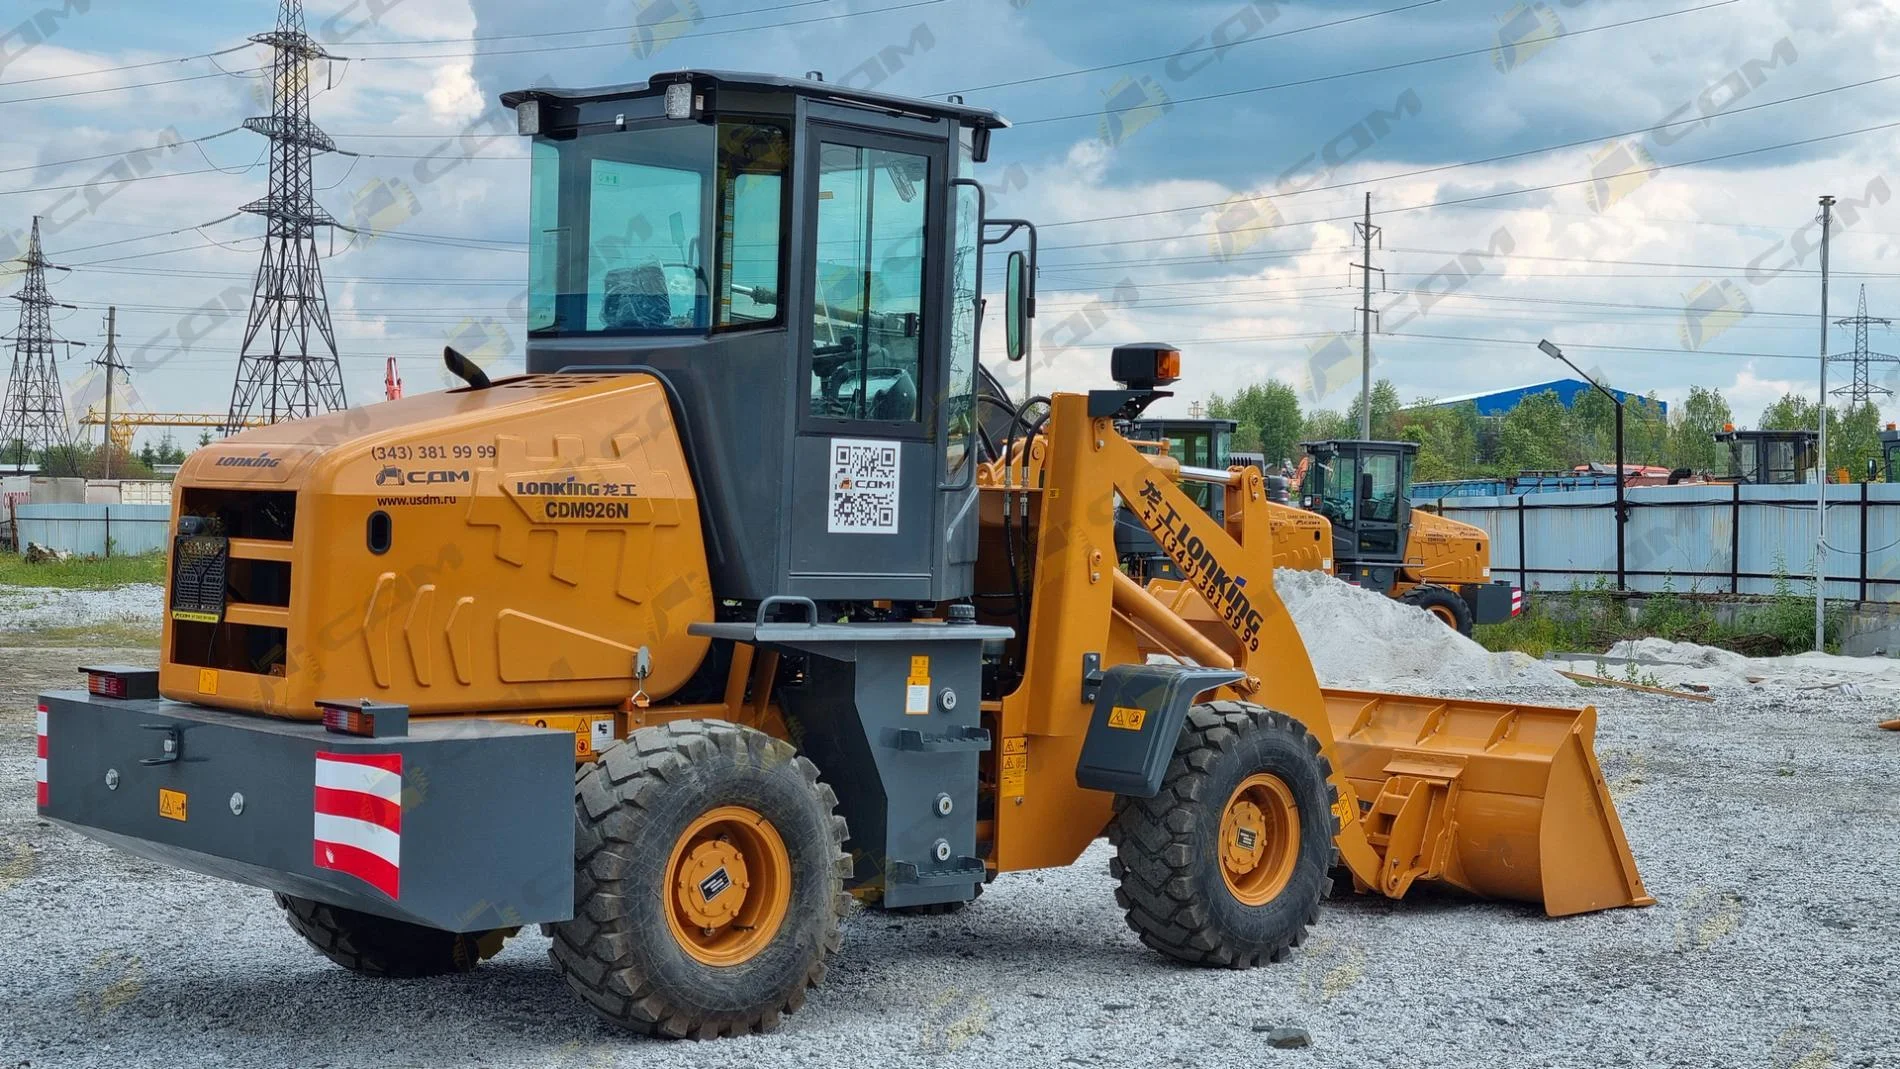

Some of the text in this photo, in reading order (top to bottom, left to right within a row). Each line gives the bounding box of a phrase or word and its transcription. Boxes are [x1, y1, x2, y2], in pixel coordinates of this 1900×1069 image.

[371, 445, 496, 461] (343) 381 99 99
[377, 494, 457, 506] www.usdm.ru
[545, 501, 629, 519] CDM926N
